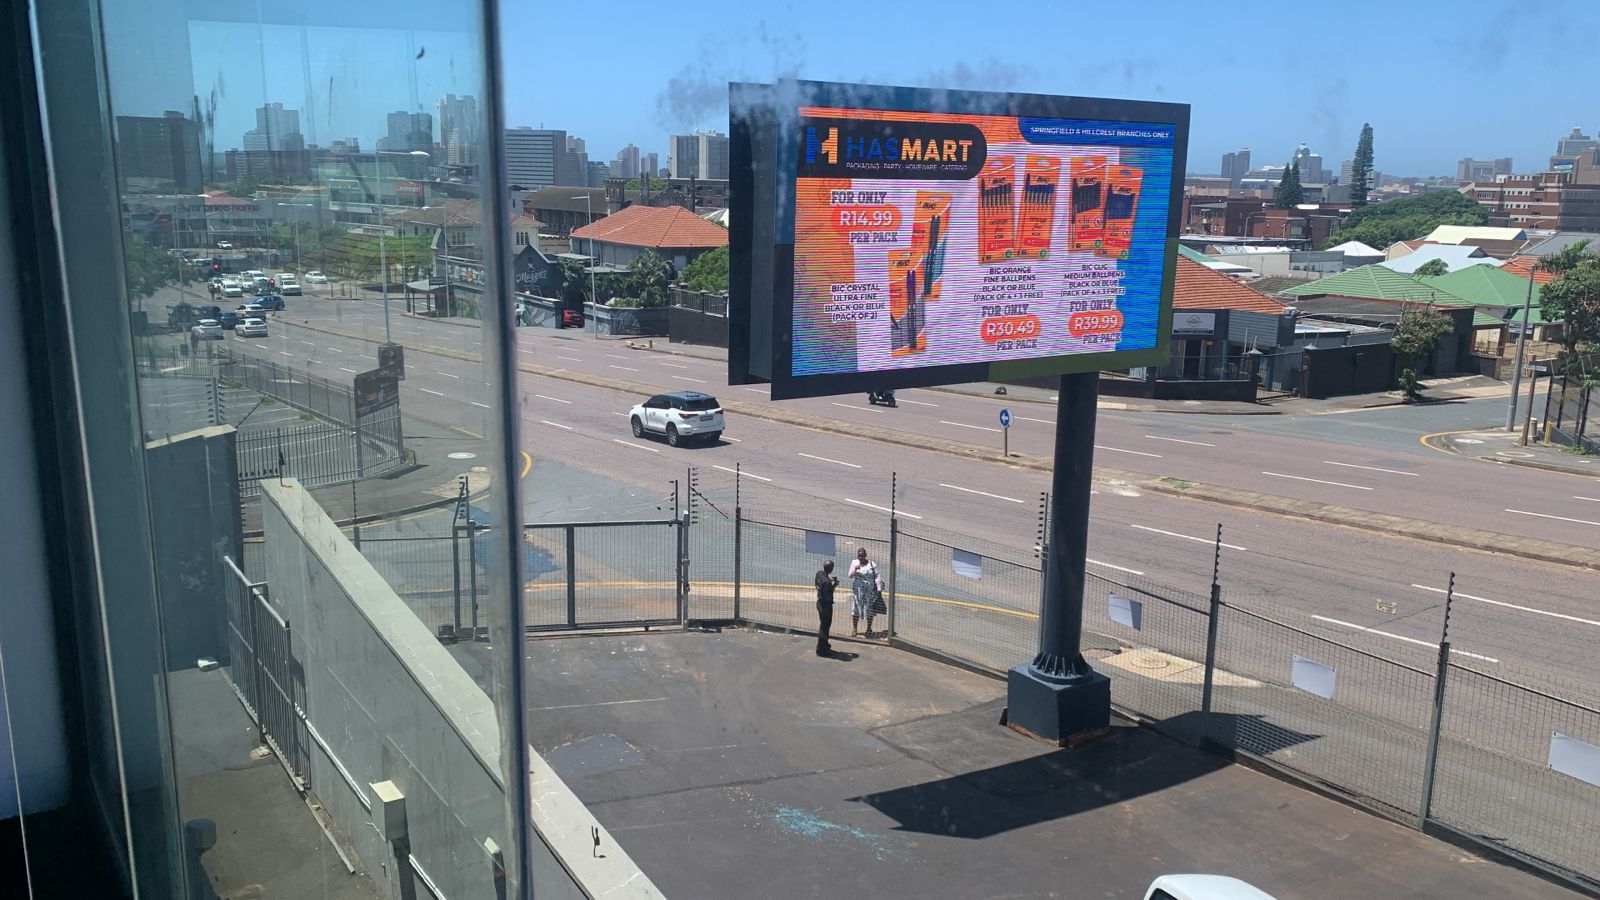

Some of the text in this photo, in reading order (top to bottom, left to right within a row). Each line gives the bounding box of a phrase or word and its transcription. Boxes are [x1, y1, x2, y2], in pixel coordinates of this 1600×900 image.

[1030, 127, 1075, 135] SPRINGFIELD
[846, 137, 973, 162] HASMART
[831, 190, 887, 204] FOR ONLY
[922, 202, 937, 210] BIC
[840, 210, 893, 226] R14.99
[850, 231, 870, 243] PER
[872, 231, 899, 243] PACK
[989, 266, 1031, 275] BIC ORANGE
[1090, 271, 1124, 279] BALLPENS
[1002, 274, 1036, 282] BALLPENS
[831, 284, 880, 293] BIC CRYSTAL
[1018, 283, 1036, 291] BLUE
[974, 294, 995, 302] (PACK
[1024, 291, 1043, 299] FREE)
[1061, 289, 1080, 297] (PACK
[825, 302, 885, 312] BLACK OR BLUE
[982, 304, 1029, 317] FOR ONLY
[1070, 299, 1113, 312] FOR ONLY
[832, 313, 857, 322] (PACK
[870, 312, 878, 320] 2)
[1074, 314, 1118, 331] R39.99
[986, 320, 1035, 336] R30.49
[1082, 332, 1120, 344] PER PACK
[996, 339, 1038, 351] PER PACK
